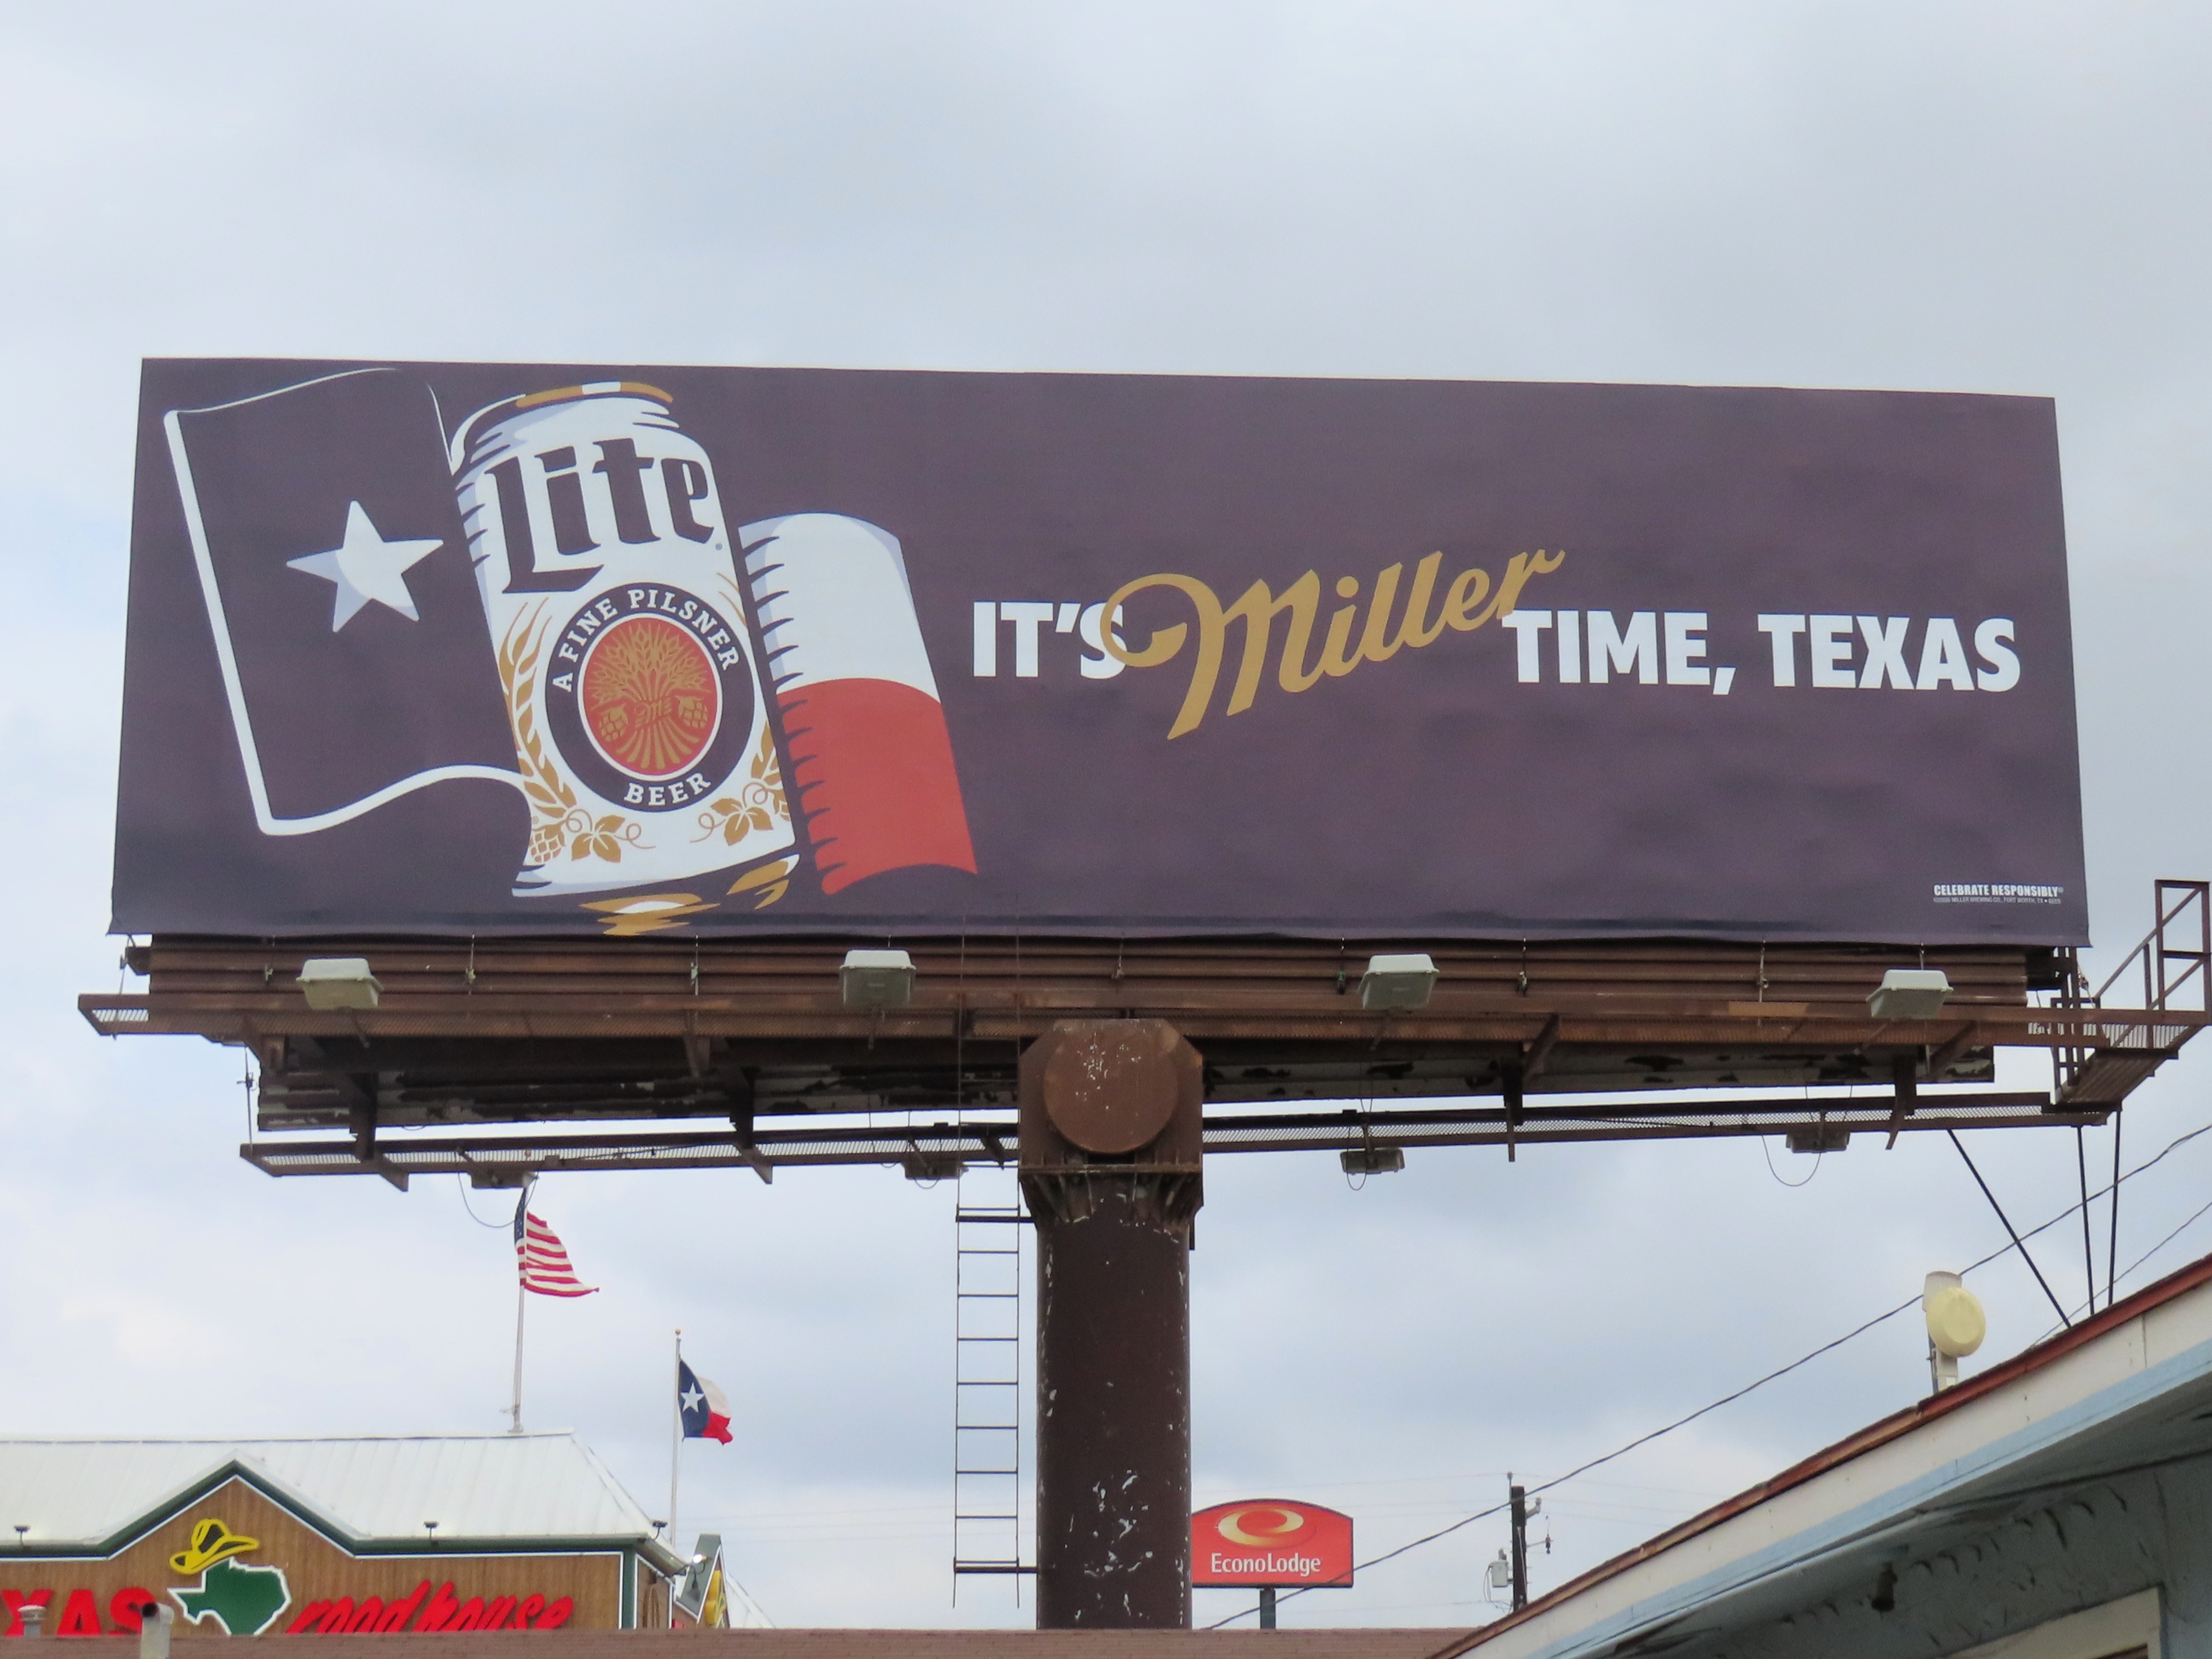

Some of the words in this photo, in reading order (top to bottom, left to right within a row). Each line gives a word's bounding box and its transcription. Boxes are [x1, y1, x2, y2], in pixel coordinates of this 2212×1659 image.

[485, 438, 714, 593] Lite
[559, 598, 618, 663] FINE
[627, 588, 741, 671] PILSNER
[973, 600, 1127, 679] IT'S
[1100, 549, 1565, 740] Miller
[1501, 608, 1736, 695] TIME,
[1757, 612, 2021, 692] TEXAS
[553, 672, 572, 692] A
[623, 772, 712, 806] BEER
[1933, 884, 1990, 896] CELEBRATE
